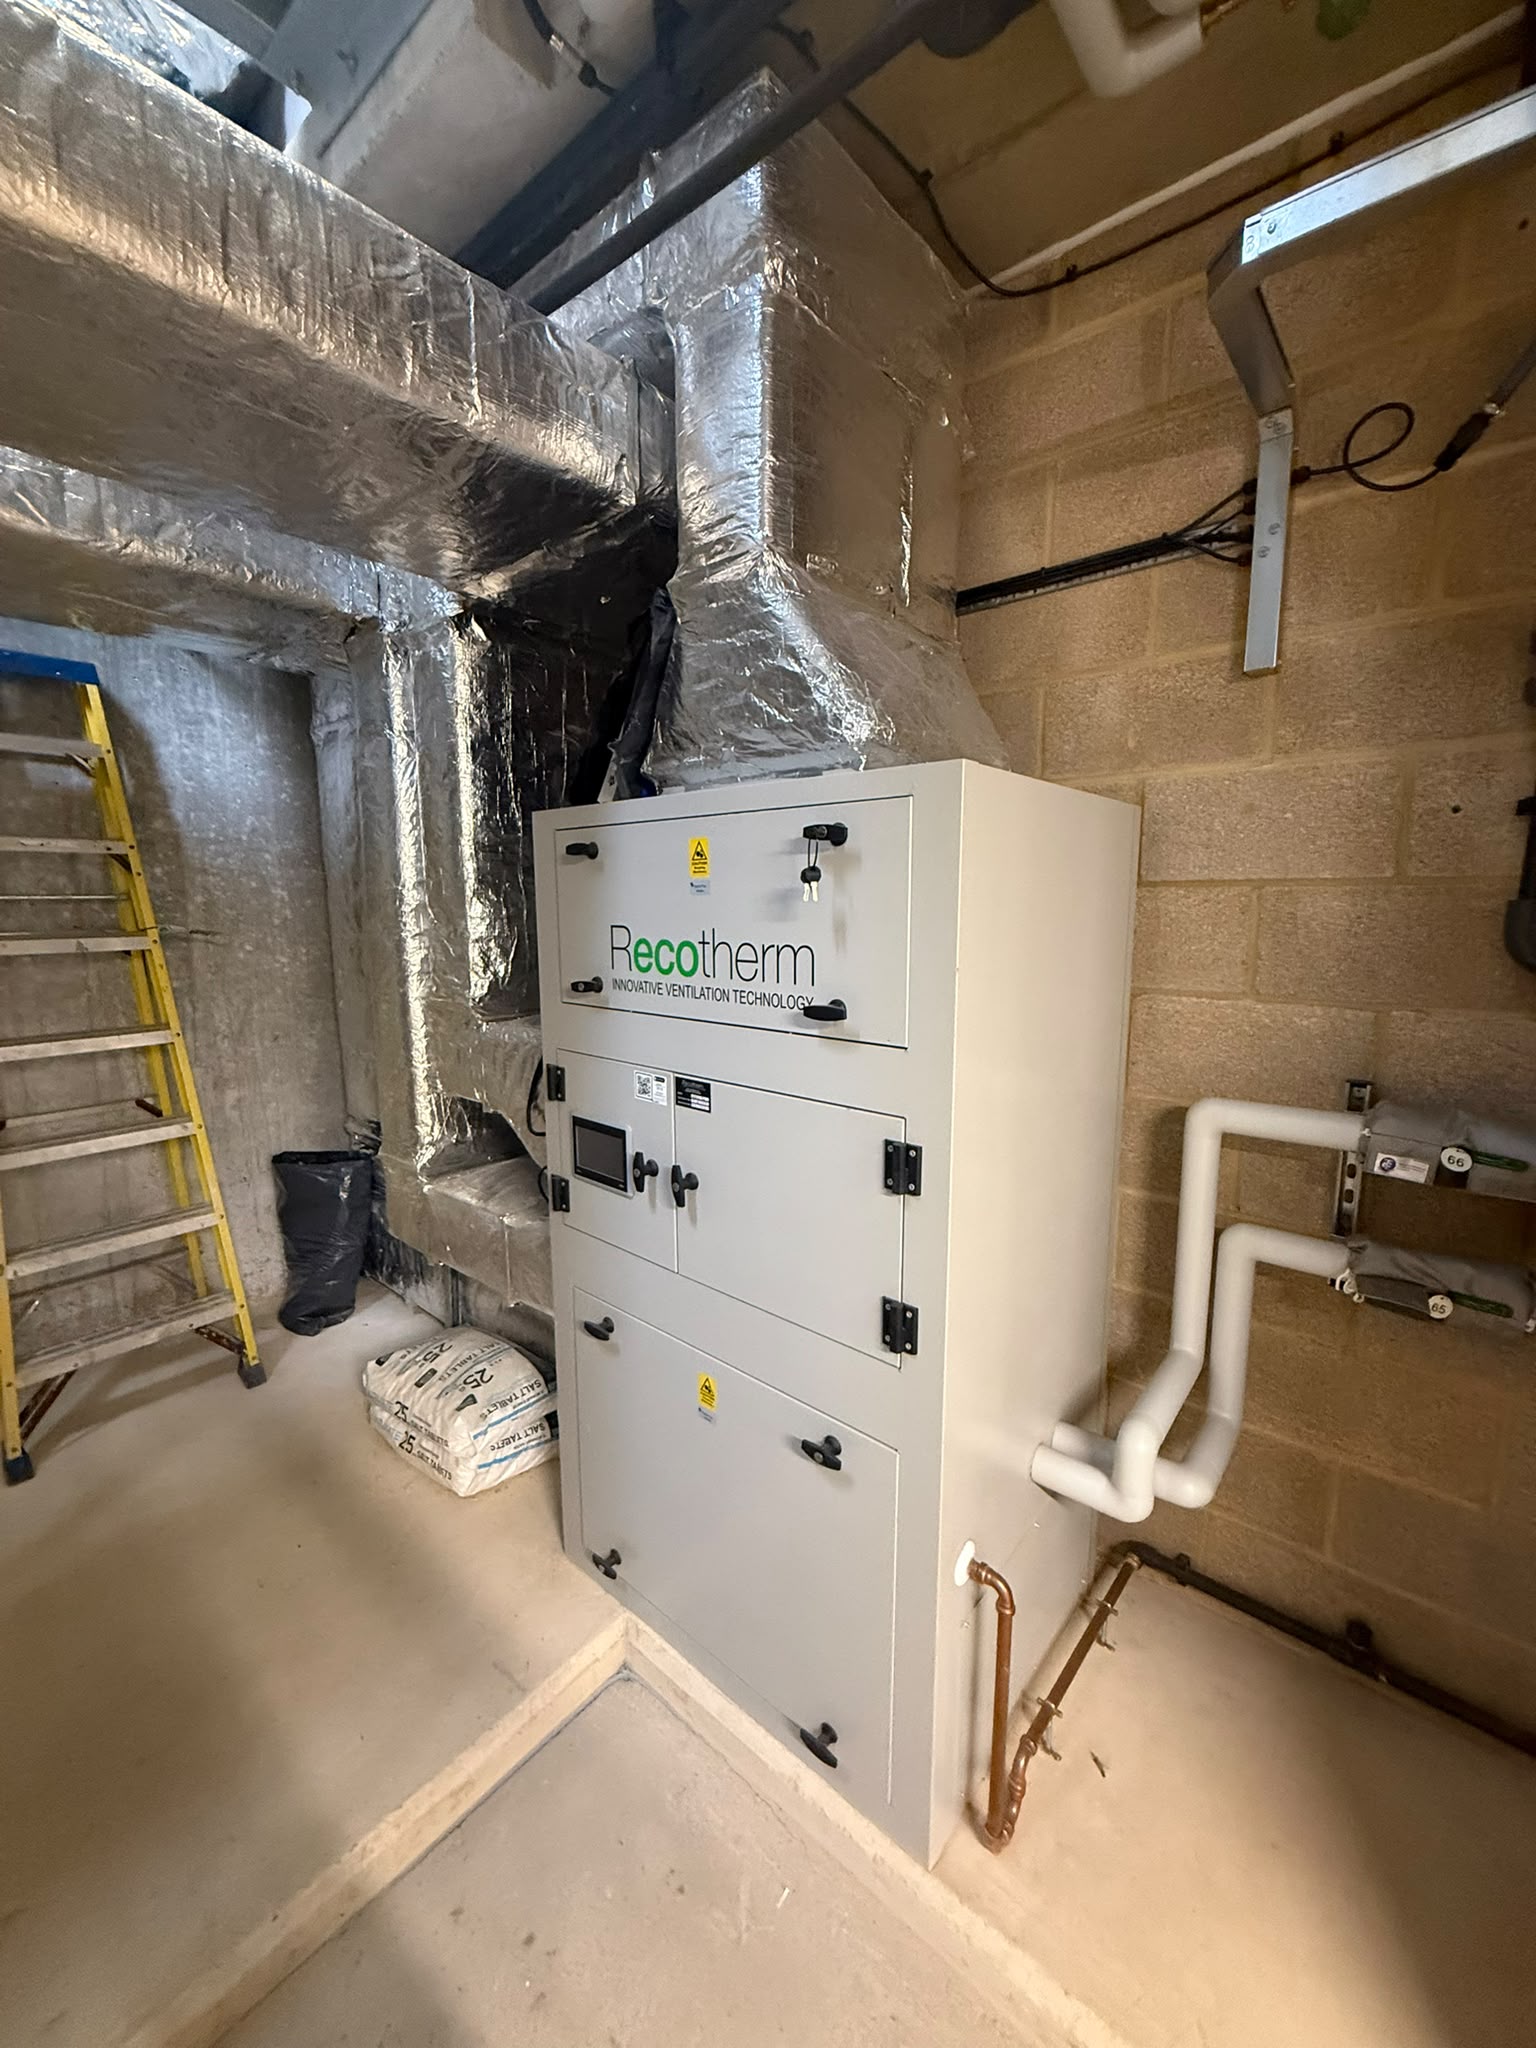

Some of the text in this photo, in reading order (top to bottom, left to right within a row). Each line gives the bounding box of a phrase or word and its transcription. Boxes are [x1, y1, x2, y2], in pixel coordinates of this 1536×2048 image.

[610, 924, 815, 987] Recotherm
[612, 978, 814, 1011] INNOVATIVE VENTILATION TECHNOLOGY
[1447, 1153, 1465, 1168] 66
[1431, 1301, 1447, 1314] 65
[463, 1367, 494, 1389] 25
[520, 1379, 542, 1397] SALT
[480, 1392, 519, 1420] TABLETS
[524, 1422, 545, 1439] SALT
[399, 1431, 416, 1454] 25
